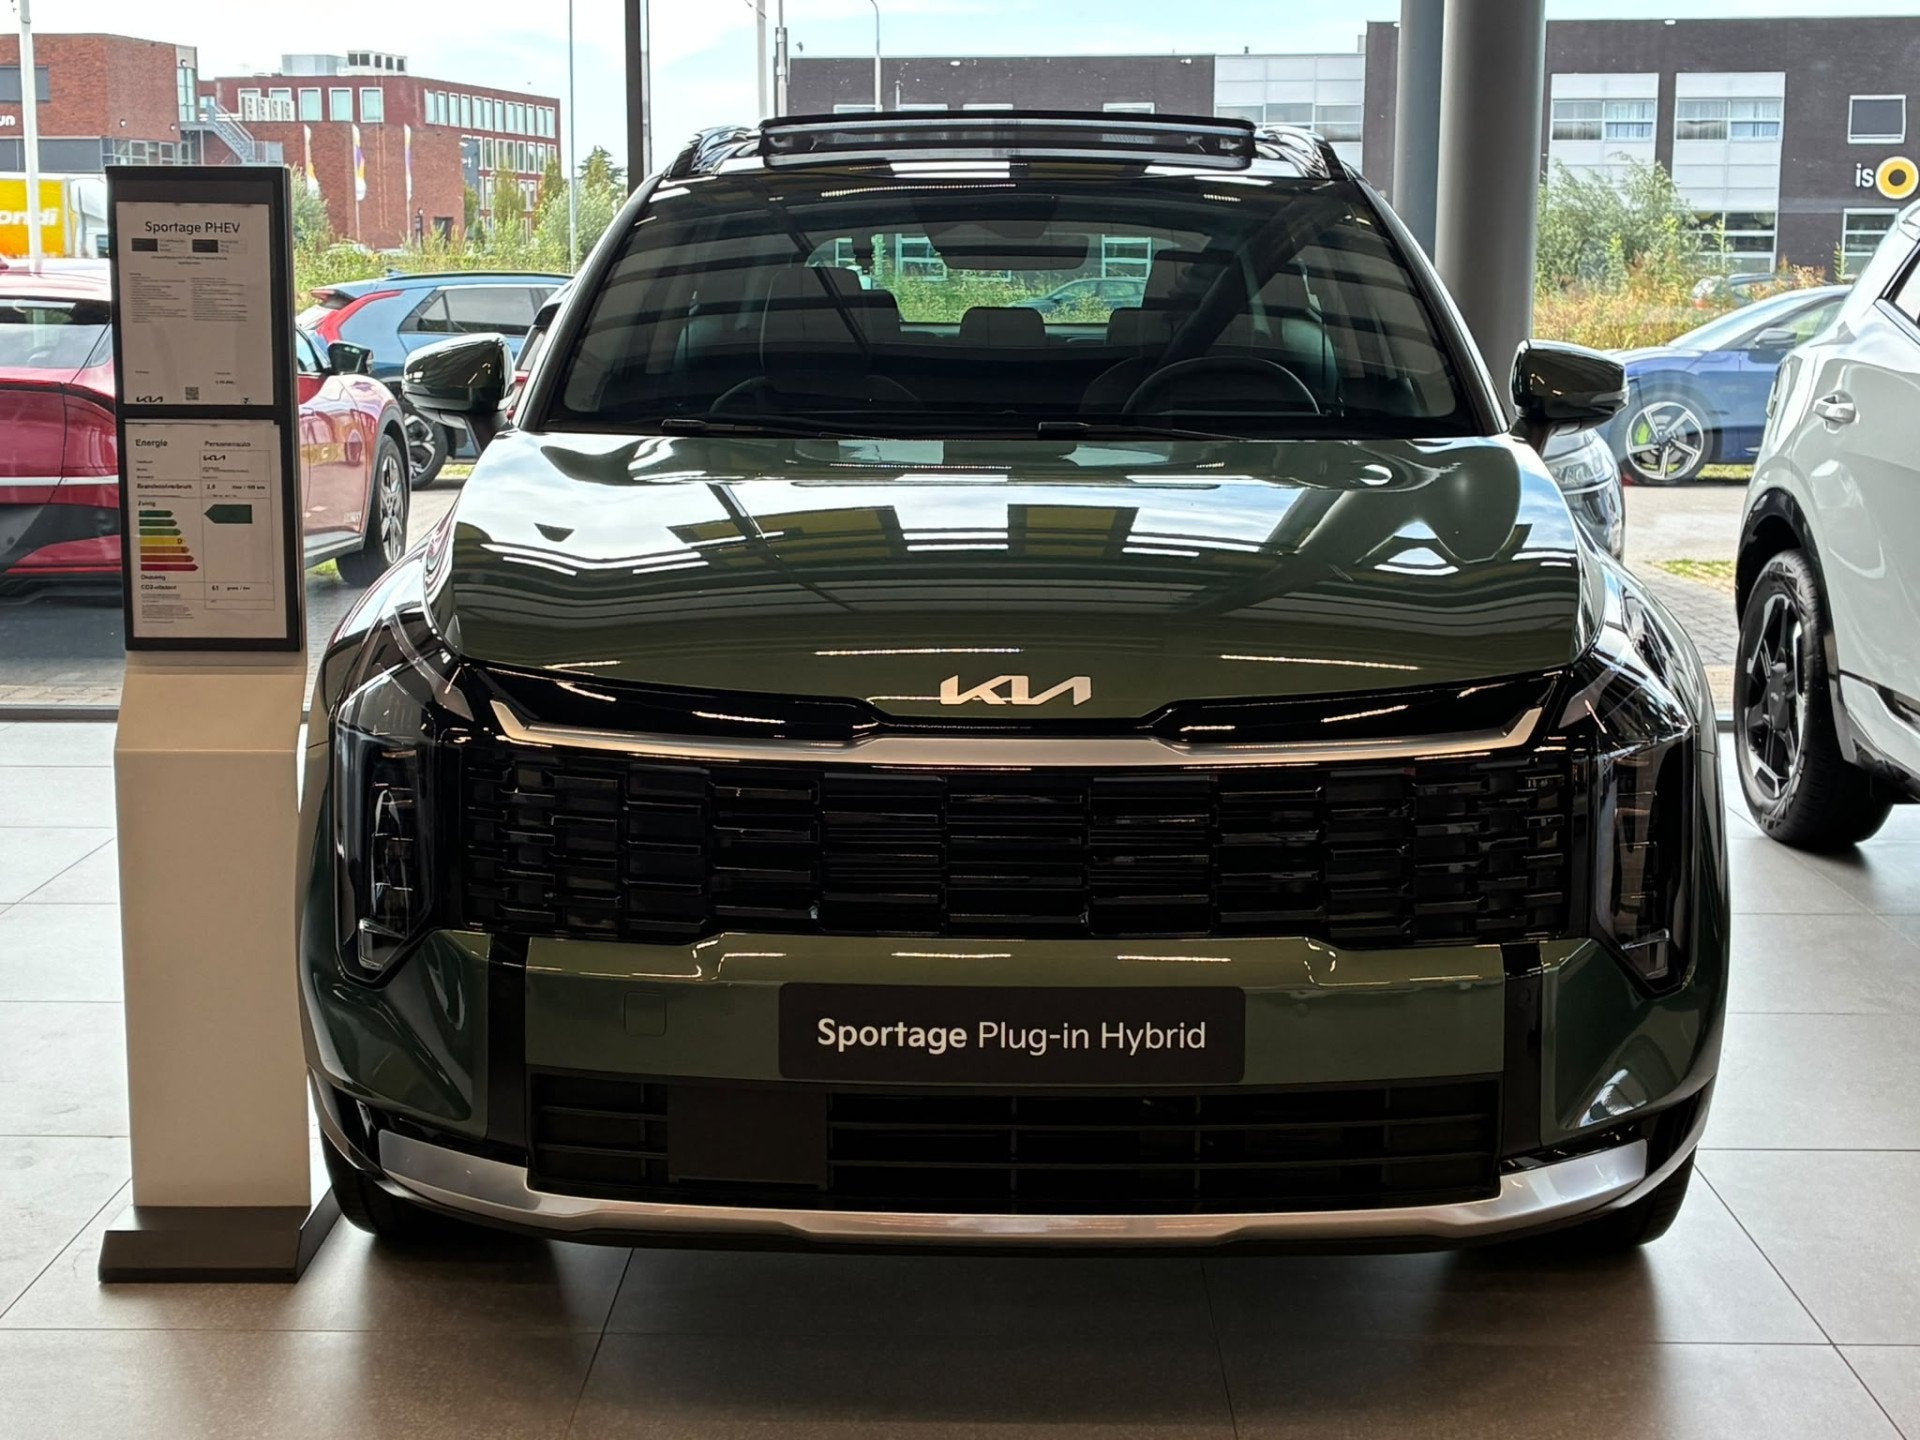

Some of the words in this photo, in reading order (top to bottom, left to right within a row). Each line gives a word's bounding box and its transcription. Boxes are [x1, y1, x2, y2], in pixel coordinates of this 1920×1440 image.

[145, 221, 201, 235] Sportage
[205, 222, 240, 233] PHEV
[135, 439, 168, 448] Energie
[940, 674, 1092, 706] KIA
[817, 1018, 968, 1055] Sportage
[978, 1021, 1089, 1056] Plug-in
[1101, 1021, 1206, 1056] Hybrid
